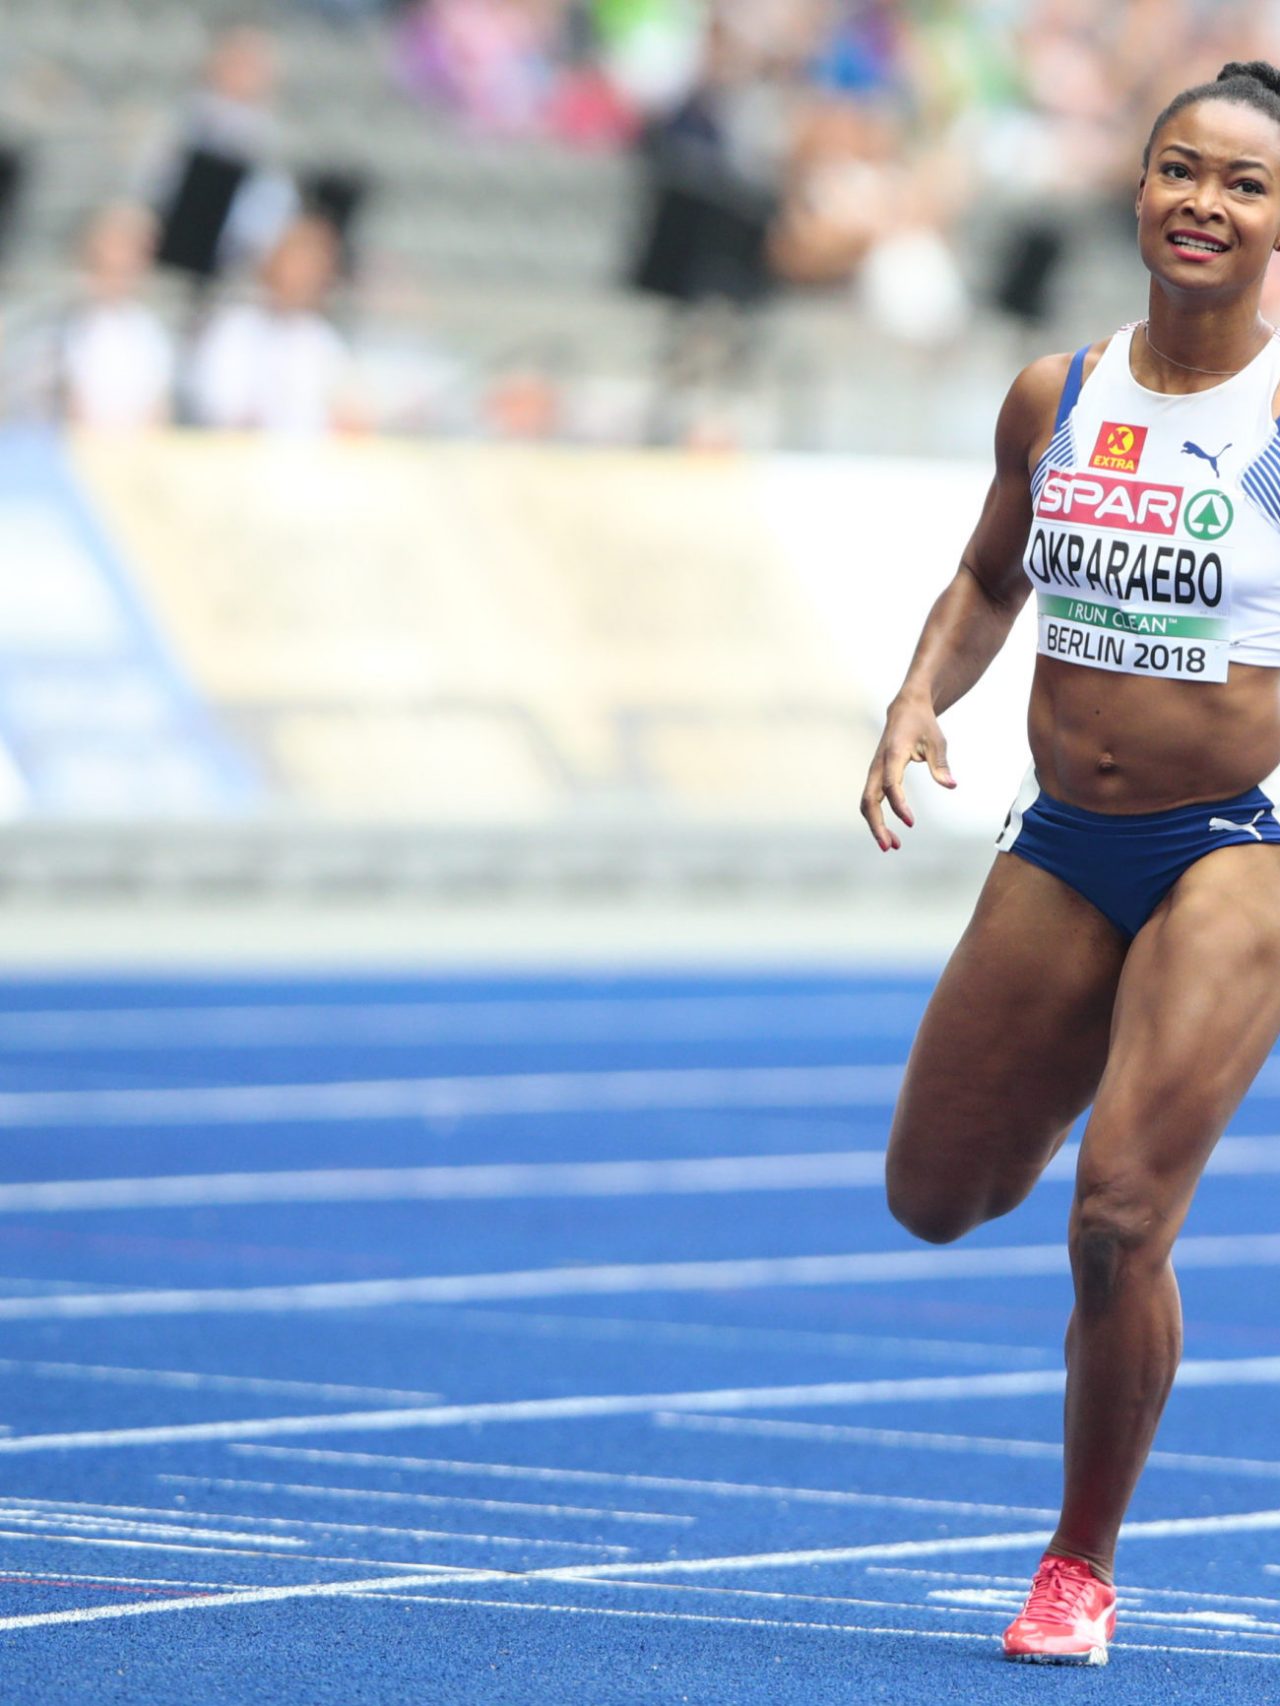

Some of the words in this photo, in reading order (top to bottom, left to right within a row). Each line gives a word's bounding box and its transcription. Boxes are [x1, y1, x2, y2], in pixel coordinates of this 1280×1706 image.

[1093, 455, 1135, 471] EXTRA
[1039, 477, 1177, 528] SPAR
[1029, 528, 1223, 608] OKPARAEBO
[1068, 602, 1073, 617] I
[1074, 604, 1107, 625] RUN
[1047, 624, 1125, 665] BERLIN
[1133, 643, 1206, 673] 2018
